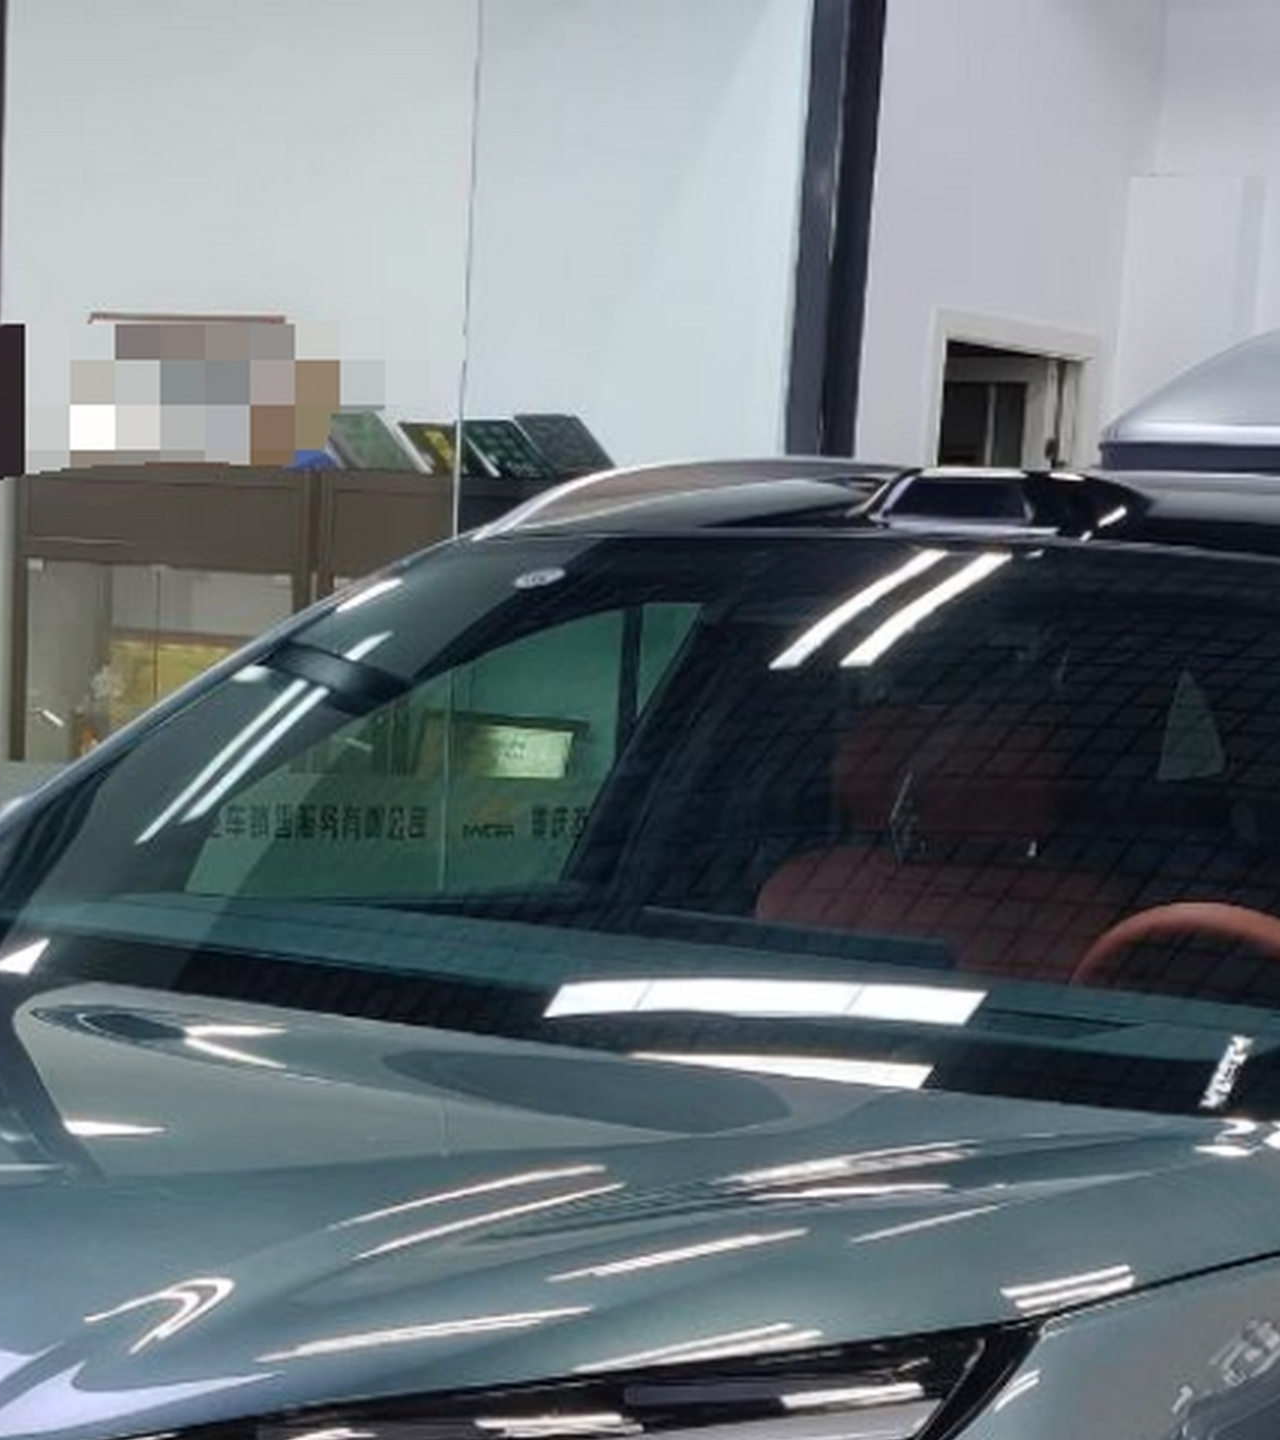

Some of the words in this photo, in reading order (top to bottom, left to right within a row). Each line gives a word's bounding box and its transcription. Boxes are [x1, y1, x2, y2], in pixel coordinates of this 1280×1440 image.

[212, 803, 429, 840] 车销售服务有限公司
